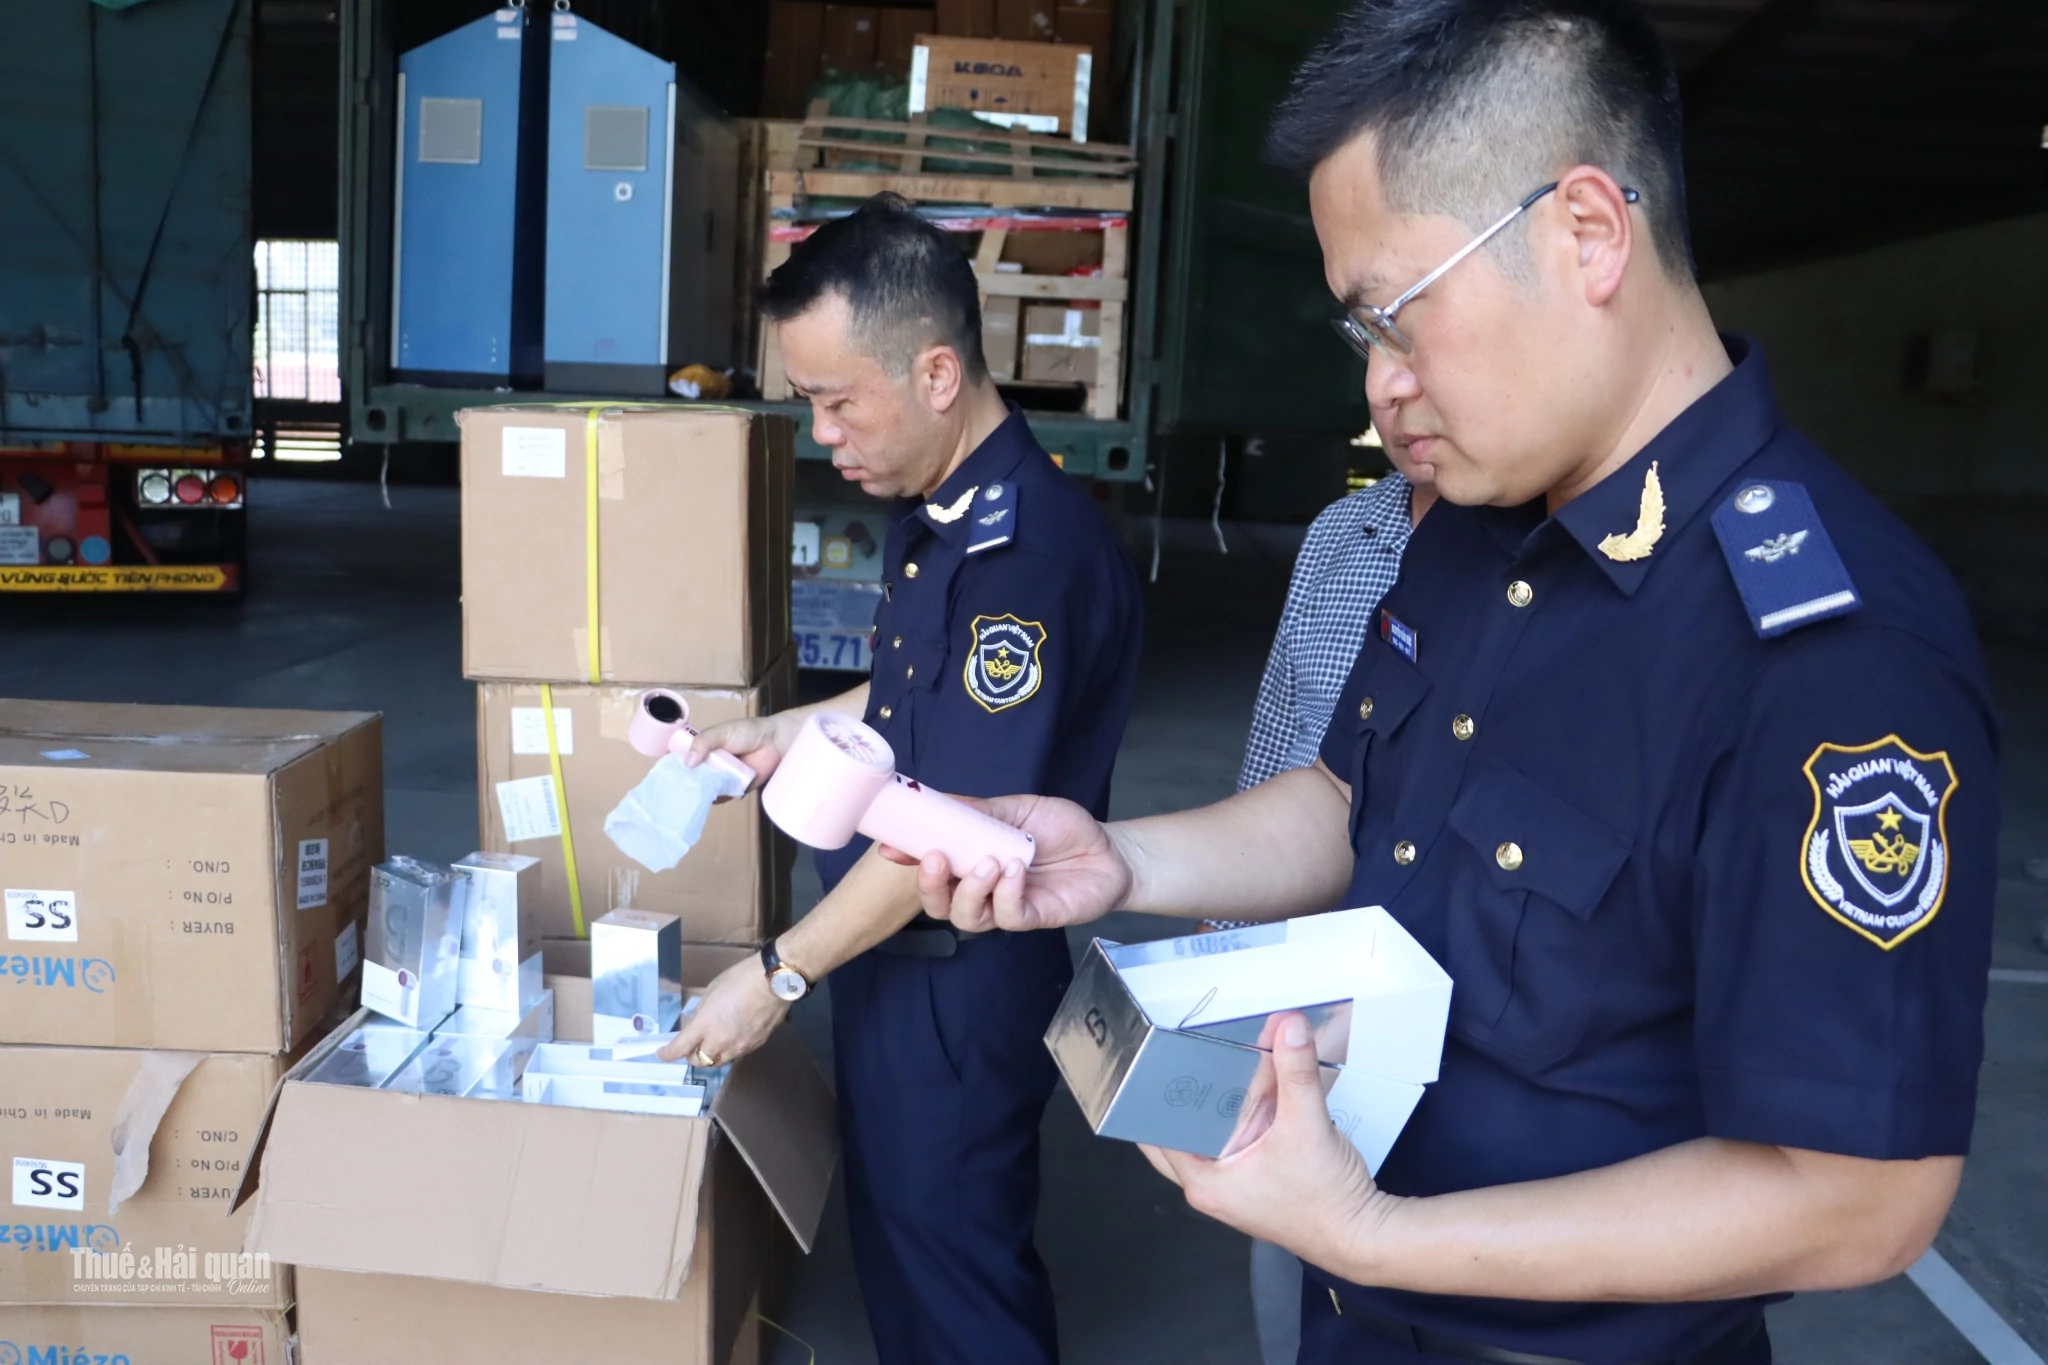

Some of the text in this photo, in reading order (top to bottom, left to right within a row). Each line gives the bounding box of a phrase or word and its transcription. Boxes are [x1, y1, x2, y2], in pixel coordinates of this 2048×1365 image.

[1848, 758, 1891, 782] QUAN
[1914, 773, 1939, 808] NAM
[23, 833, 36, 844] in
[43, 834, 80, 846] Made
[182, 891, 203, 904] No
[207, 891, 233, 904] P/O
[24, 900, 72, 929] SS
[1839, 899, 1885, 928] VIETNAM
[182, 921, 235, 934] BUYER
[34, 1108, 48, 1120] in
[55, 1108, 91, 1121] Made
[190, 1158, 211, 1171] No
[214, 1158, 240, 1171] P/O
[30, 1169, 80, 1199] SS
[190, 1186, 235, 1200] UYER
